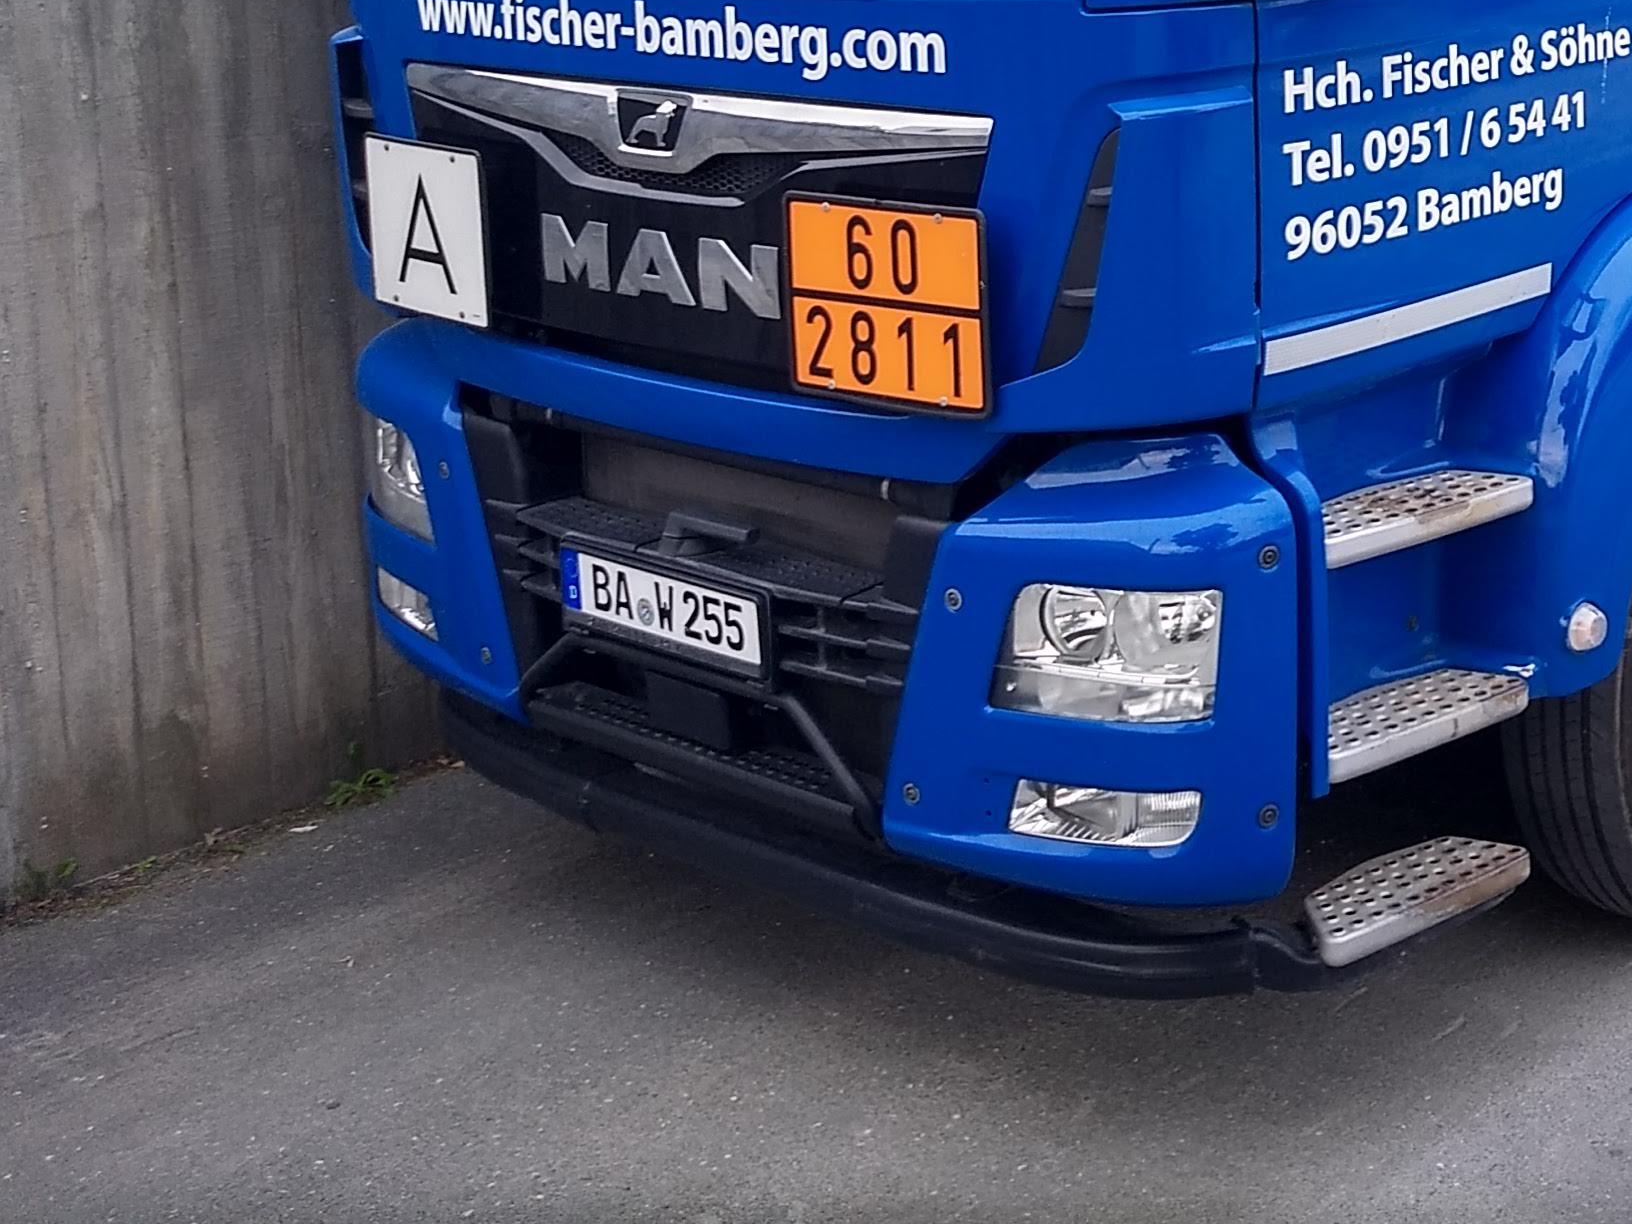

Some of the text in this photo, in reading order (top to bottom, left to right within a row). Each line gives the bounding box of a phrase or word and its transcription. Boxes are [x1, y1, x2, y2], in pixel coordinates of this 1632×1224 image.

[1284, 23, 1632, 114] Hch. Fischer & Söhne
[1282, 133, 1355, 186] Tel.
[1363, 117, 1450, 173] 0951
[1460, 110, 1475, 156] /
[399, 173, 459, 295] A
[846, 215, 918, 295] 60
[1284, 170, 1564, 261] 96052 Bamberg
[540, 213, 782, 320] MAN
[805, 305, 964, 399] 2811
[592, 563, 634, 620] BA
